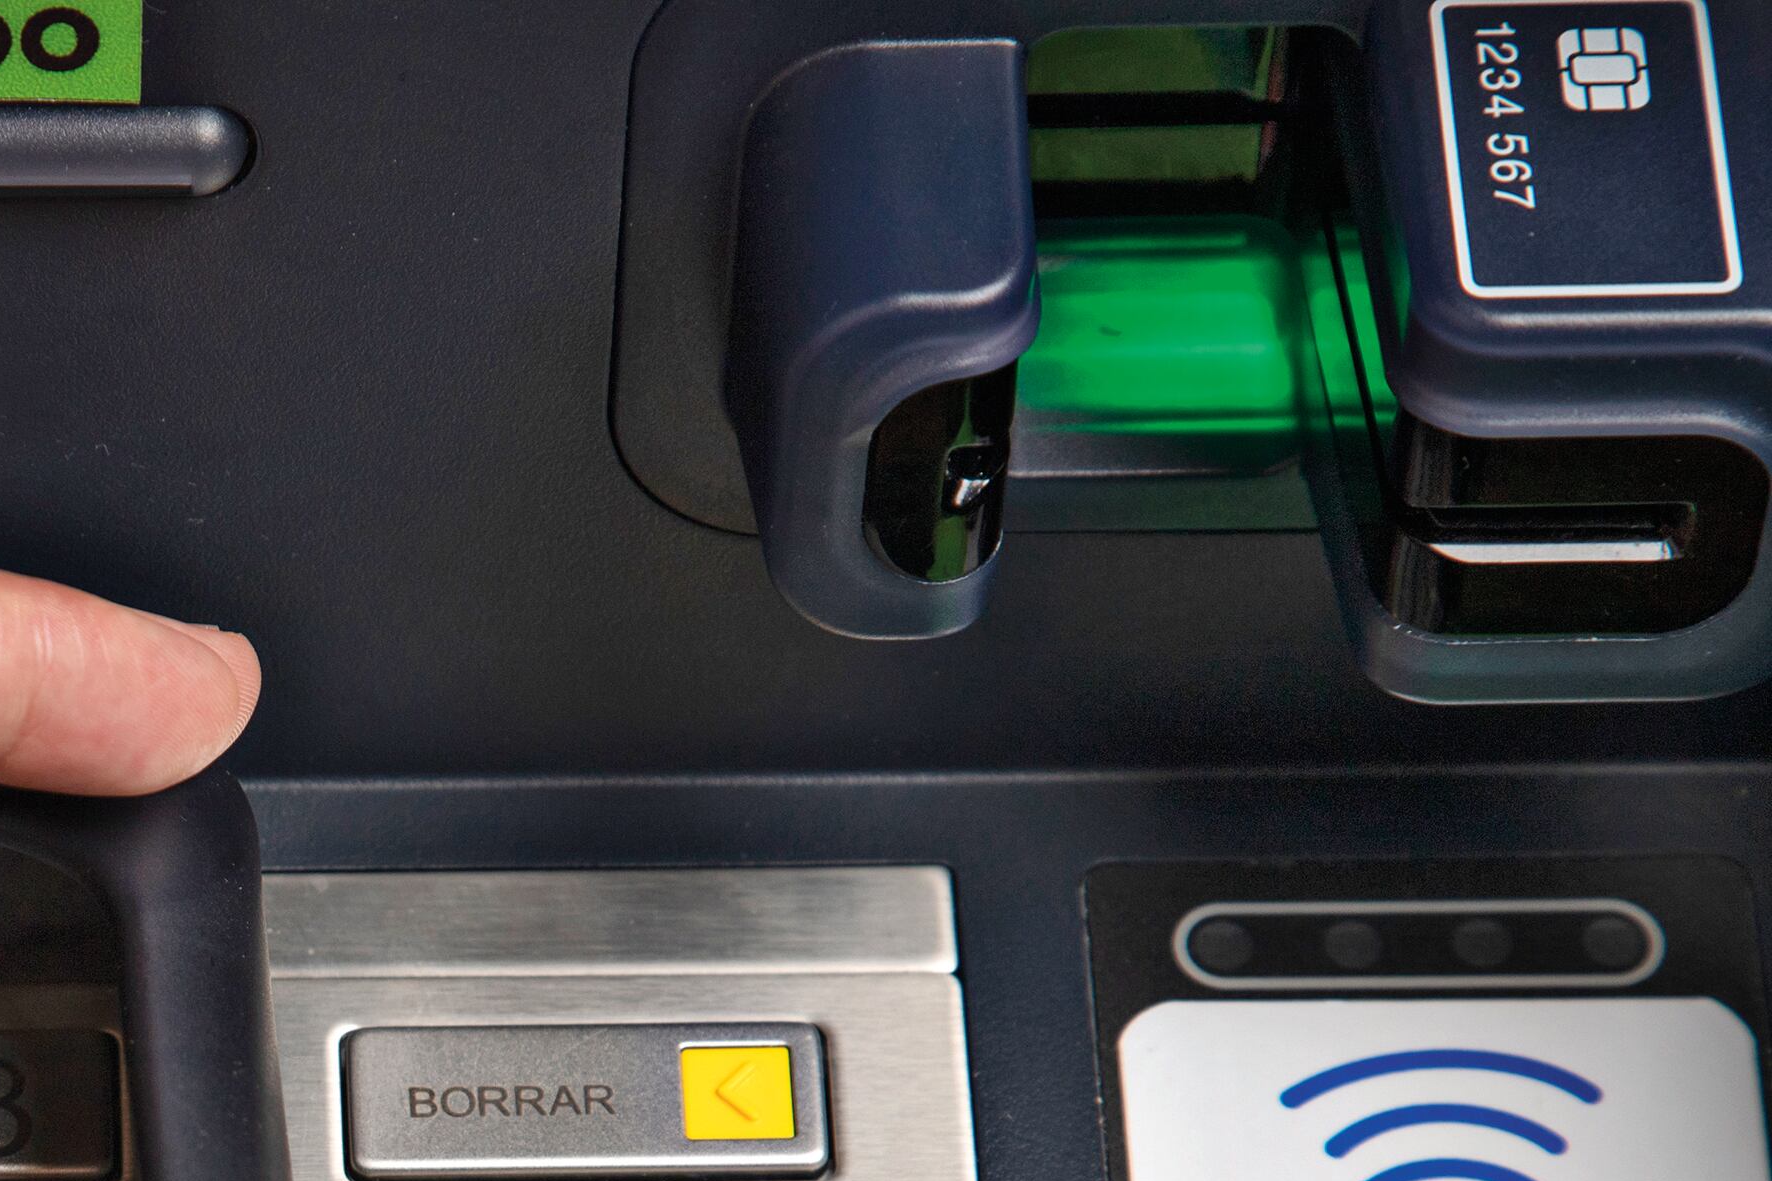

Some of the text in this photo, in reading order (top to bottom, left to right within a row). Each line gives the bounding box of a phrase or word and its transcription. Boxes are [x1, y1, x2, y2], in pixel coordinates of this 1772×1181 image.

[1474, 21, 1536, 209] 1234 567
[407, 1083, 617, 1119] BORRAR
